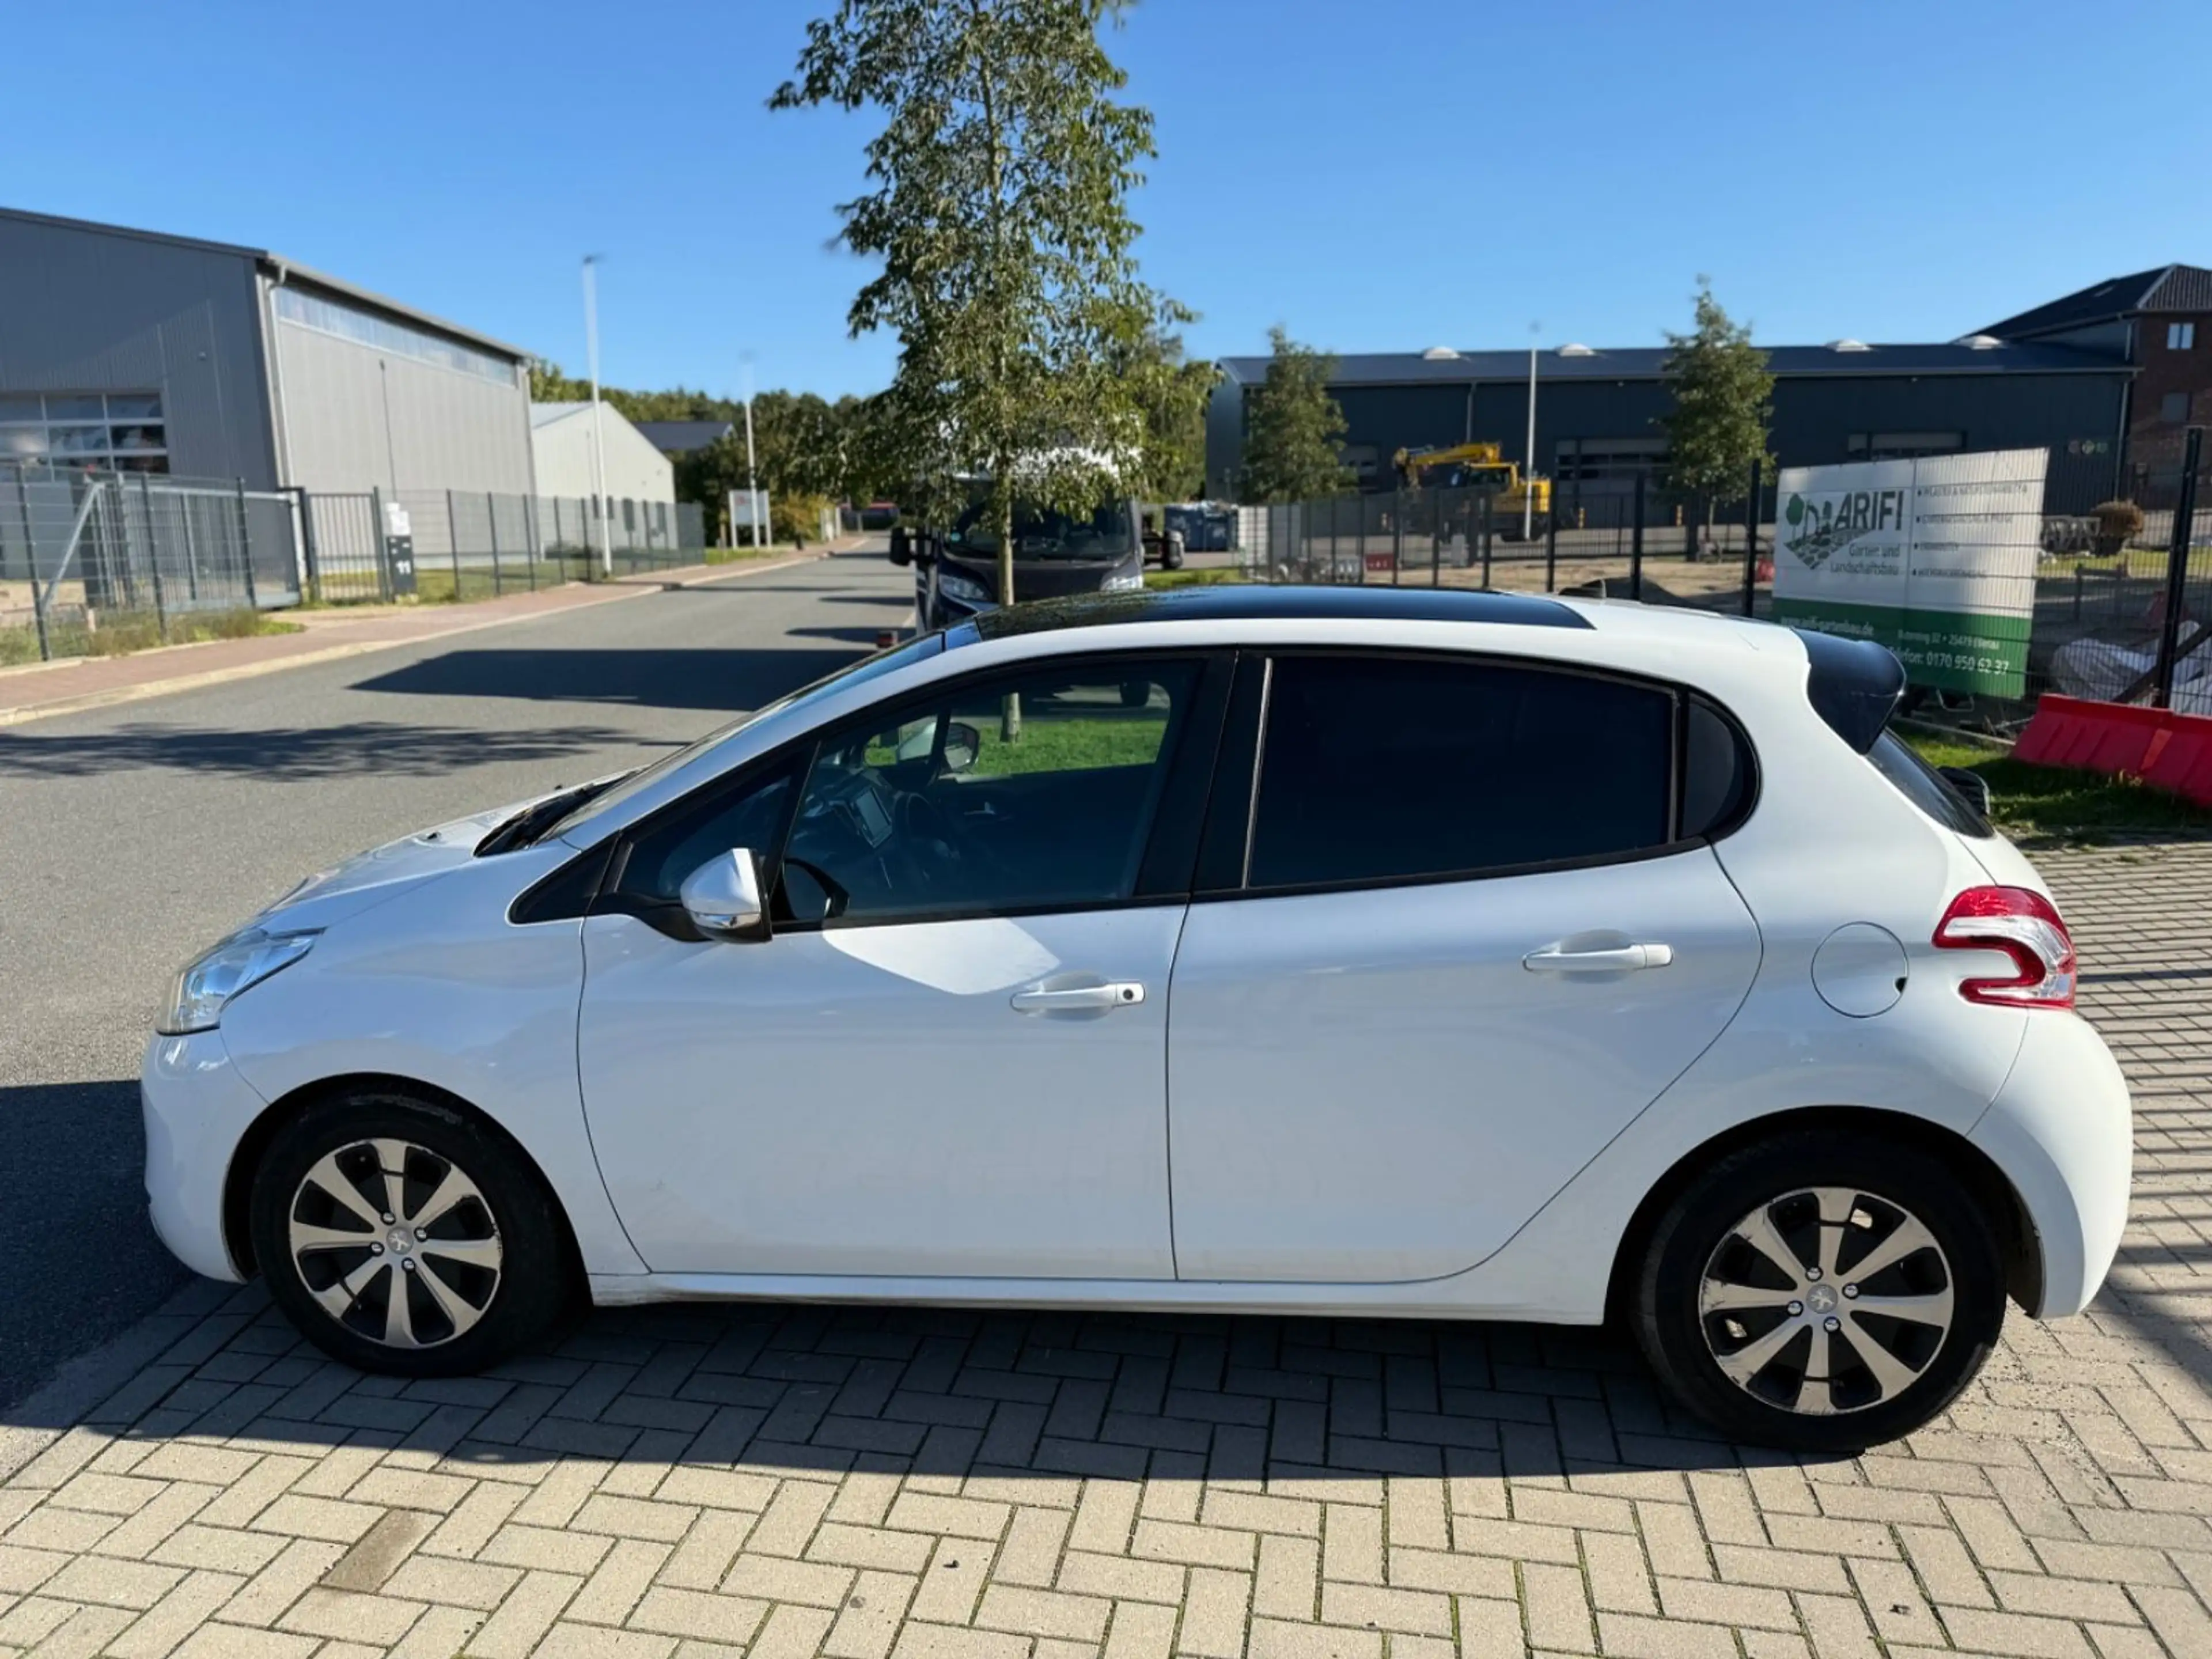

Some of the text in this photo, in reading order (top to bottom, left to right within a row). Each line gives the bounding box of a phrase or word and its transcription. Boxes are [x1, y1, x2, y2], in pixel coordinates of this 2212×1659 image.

[1834, 491, 1903, 531] ARIFI
[1881, 543, 1900, 558] und
[396, 560, 411, 574] 11
[1926, 650, 1952, 668] 0170
